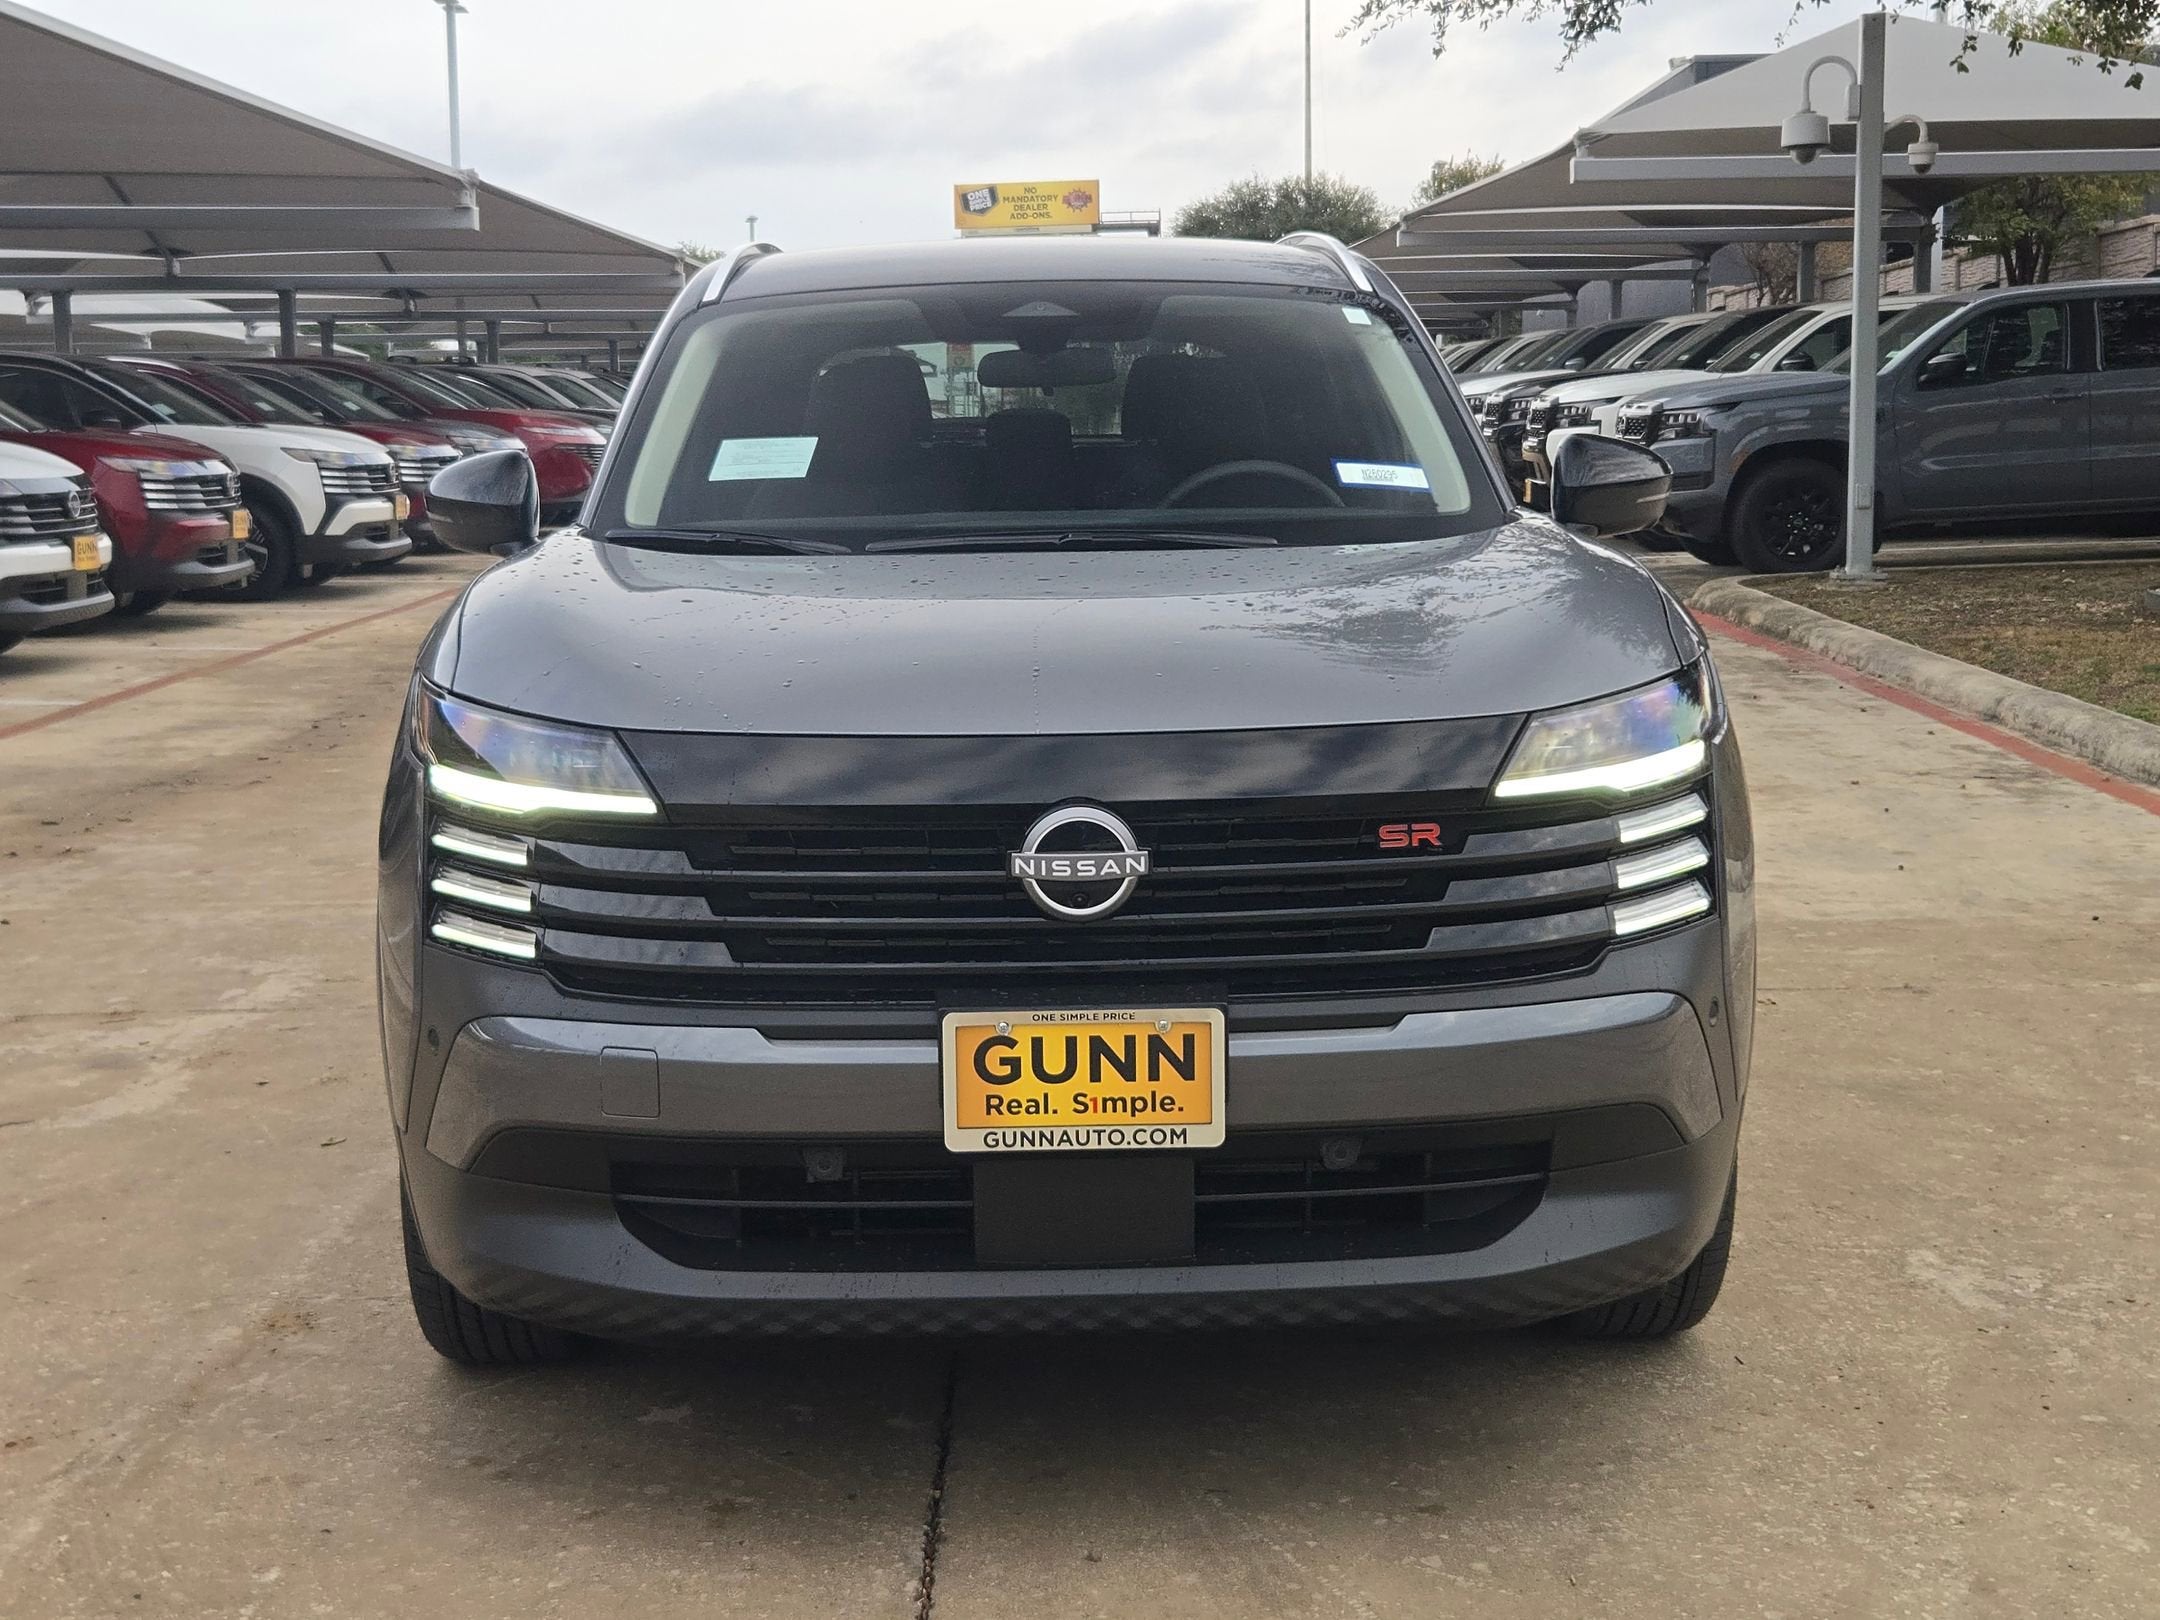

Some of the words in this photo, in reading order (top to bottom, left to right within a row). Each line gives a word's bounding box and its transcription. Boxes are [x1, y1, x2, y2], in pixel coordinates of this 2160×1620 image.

[967, 189, 990, 201] ONE
[1003, 194, 1058, 203] MANDATORY
[1014, 203, 1048, 211] DEALER
[1378, 822, 1442, 849] SR
[1014, 855, 1147, 877] NISSAN
[1032, 1013, 1056, 1022] ONE
[1060, 1012, 1099, 1021] SIMPLE
[1103, 1011, 1136, 1020] PRICE
[973, 1033, 1196, 1085] GUNN
[985, 1092, 1058, 1116] Real.
[983, 1128, 1188, 1148] GUNNAUTO.COM
